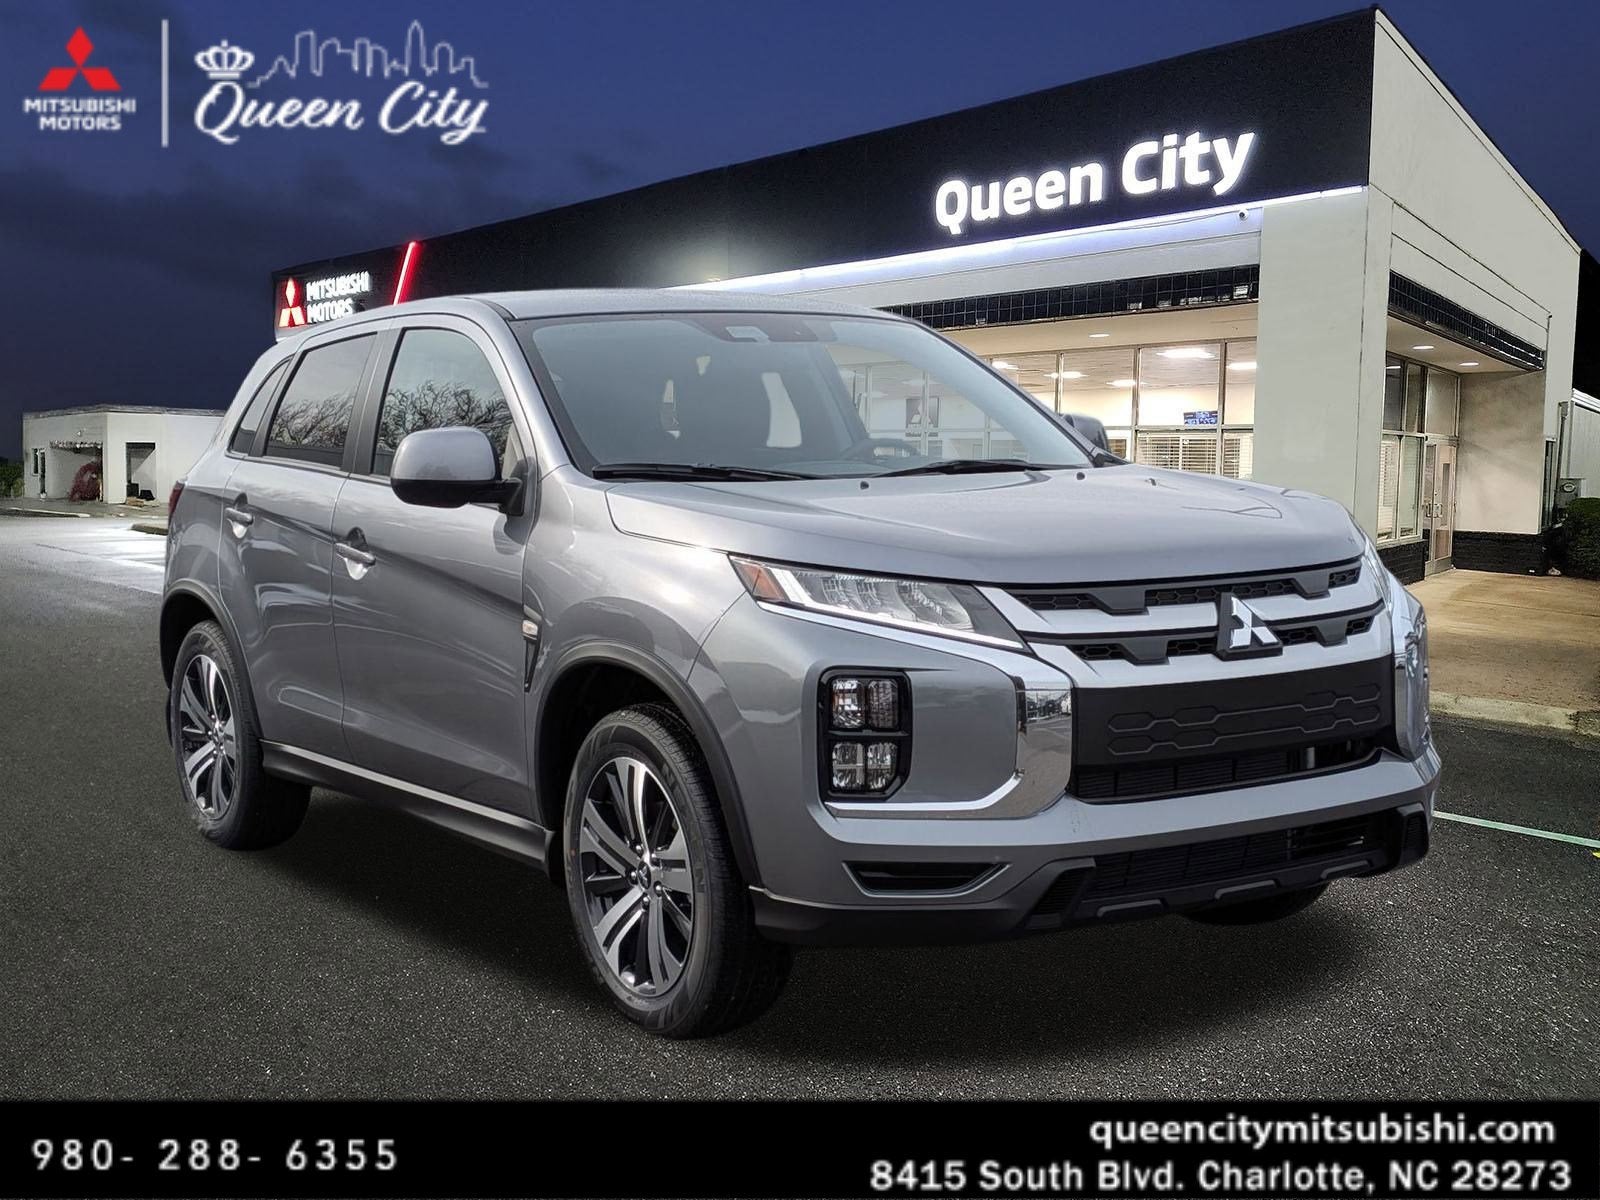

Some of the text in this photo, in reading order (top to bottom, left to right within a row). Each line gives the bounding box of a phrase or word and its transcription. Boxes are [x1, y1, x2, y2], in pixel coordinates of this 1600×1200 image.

[935, 131, 1256, 235] Queen City
[306, 271, 370, 302] MITSUBISHI
[307, 298, 353, 324] MOTORS
